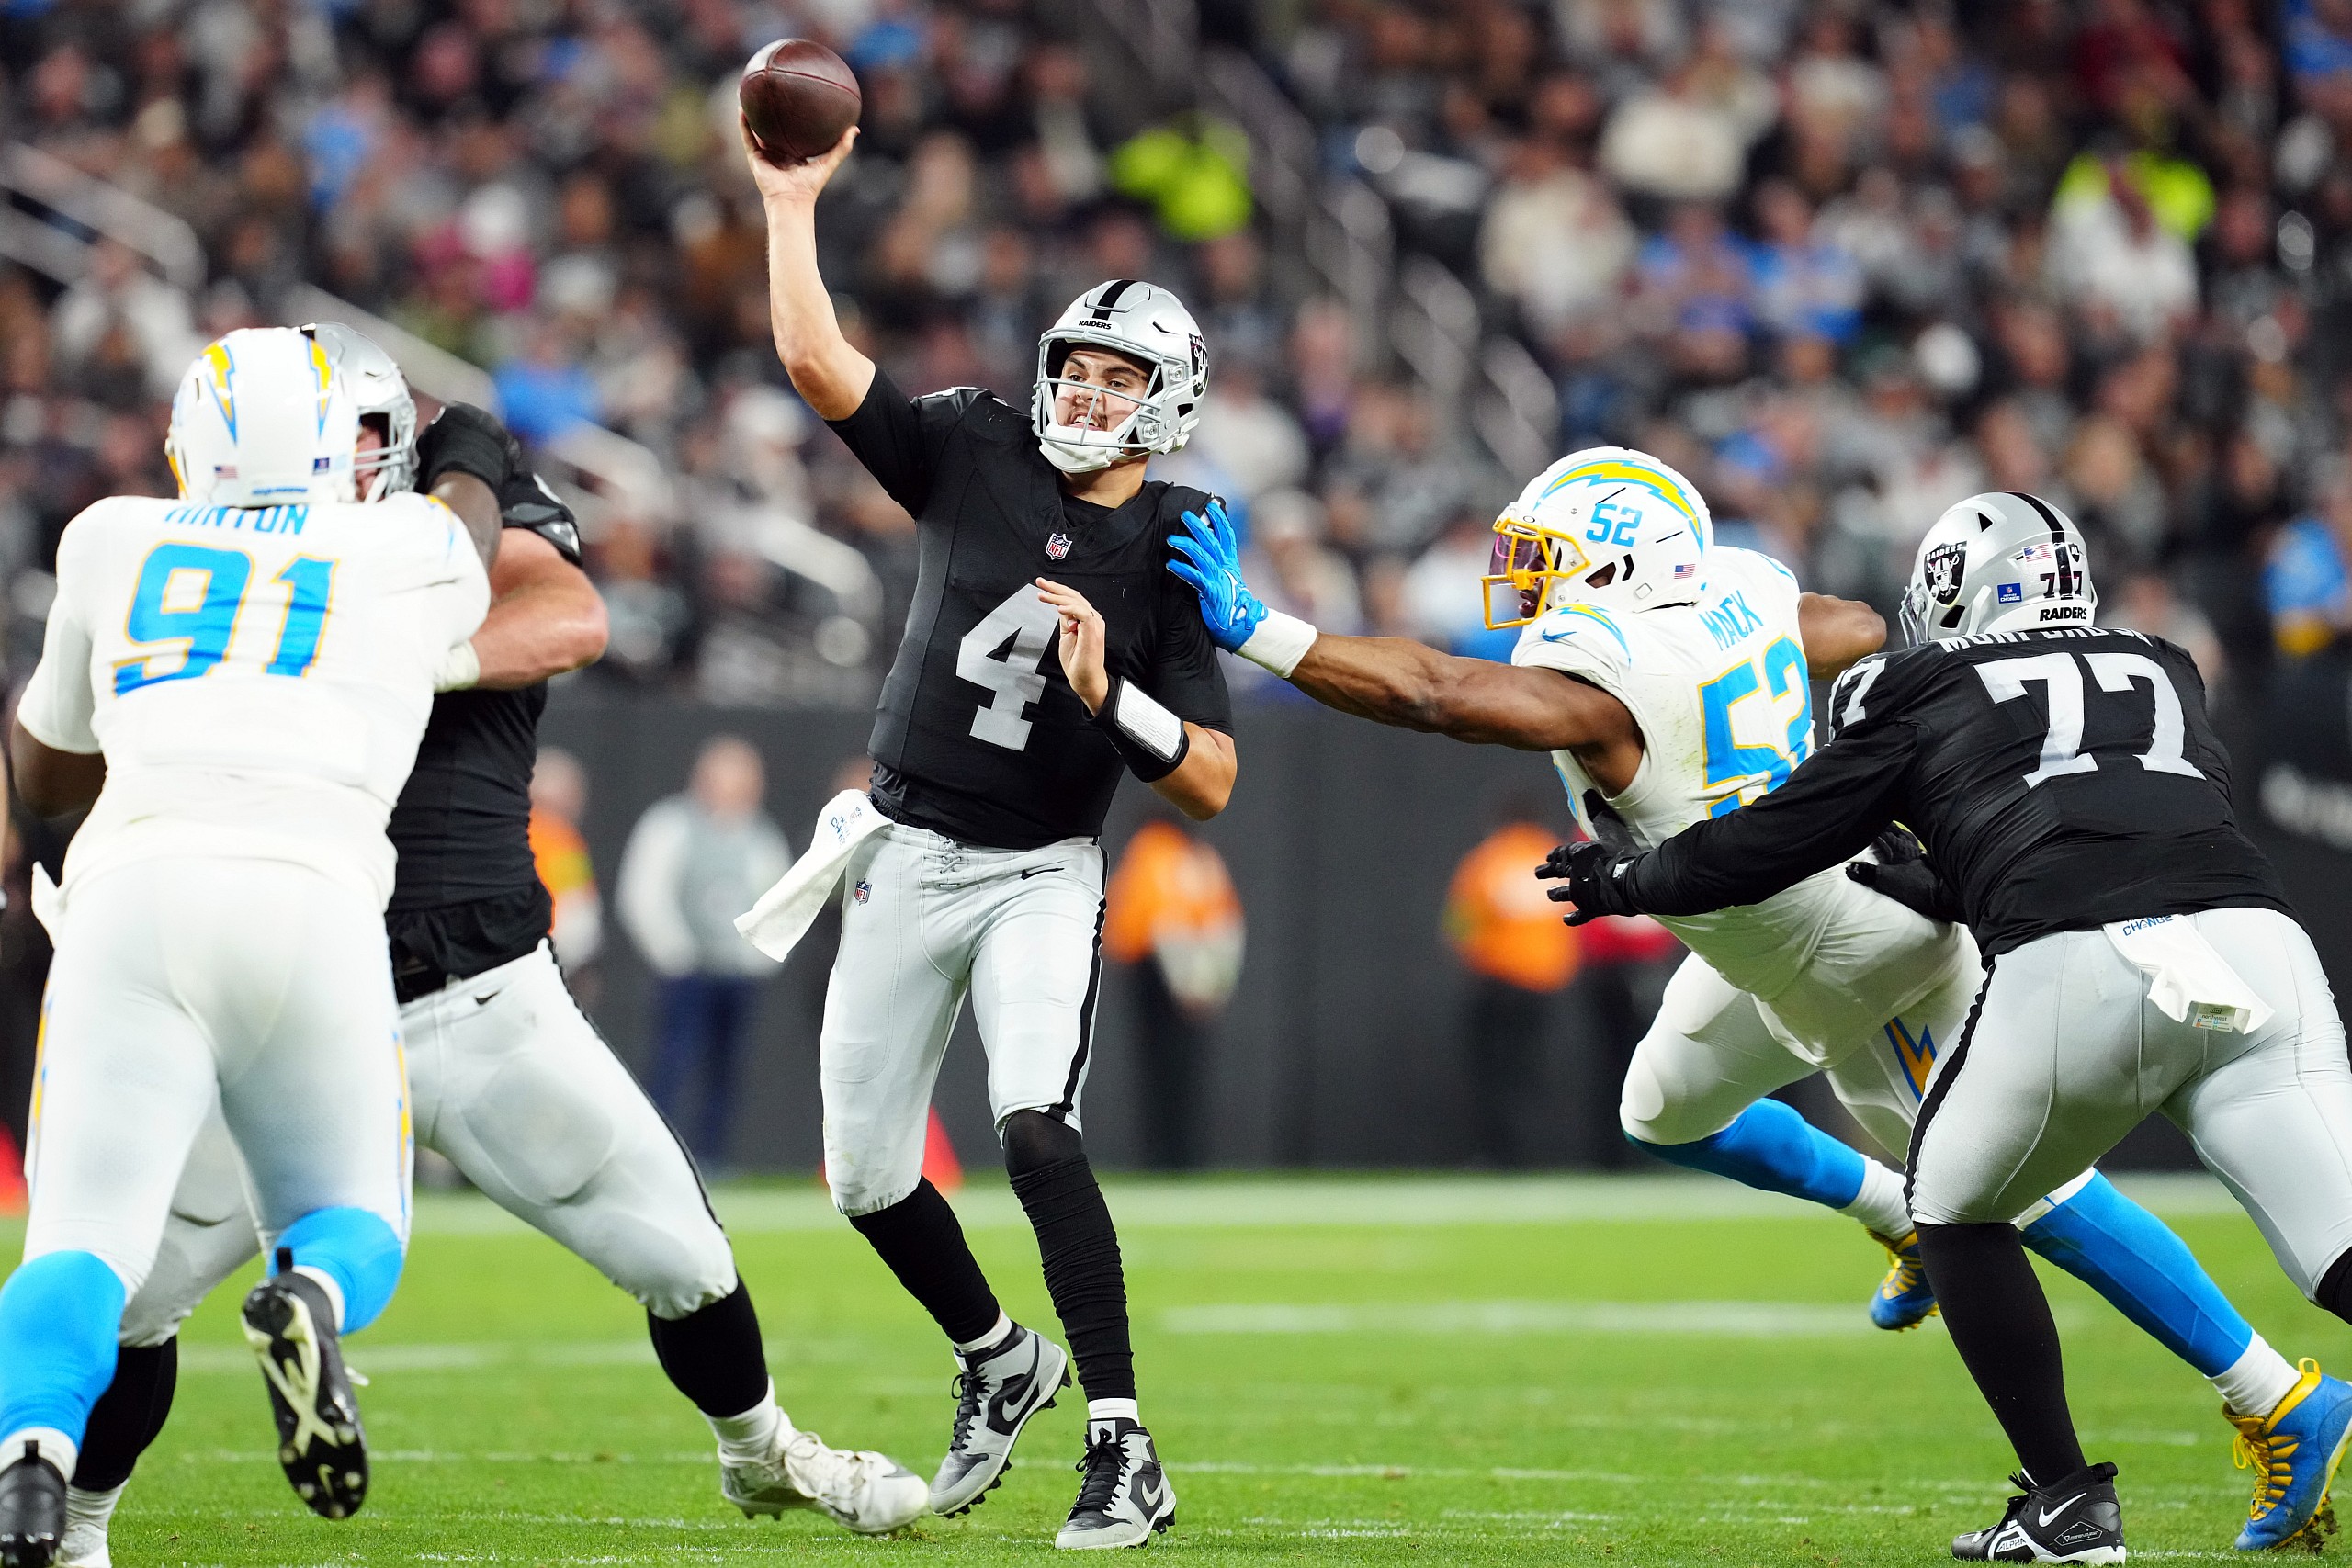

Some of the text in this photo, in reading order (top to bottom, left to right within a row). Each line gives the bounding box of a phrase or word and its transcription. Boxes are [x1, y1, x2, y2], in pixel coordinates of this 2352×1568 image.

[1078, 320, 1113, 331] RAIDERS
[1586, 502, 1643, 547] 52
[1048, 543, 1064, 557] NFL
[1926, 543, 1963, 561] RAIDERS
[111, 538, 341, 699] 91
[1698, 589, 1764, 651] MACK
[2039, 606, 2087, 622] RAIDERS
[956, 583, 1059, 752] 4
[1697, 631, 1814, 820] 52
[1973, 651, 2207, 790] 77
[855, 888, 866, 901] NFL
[2122, 914, 2175, 937] CHANGE
